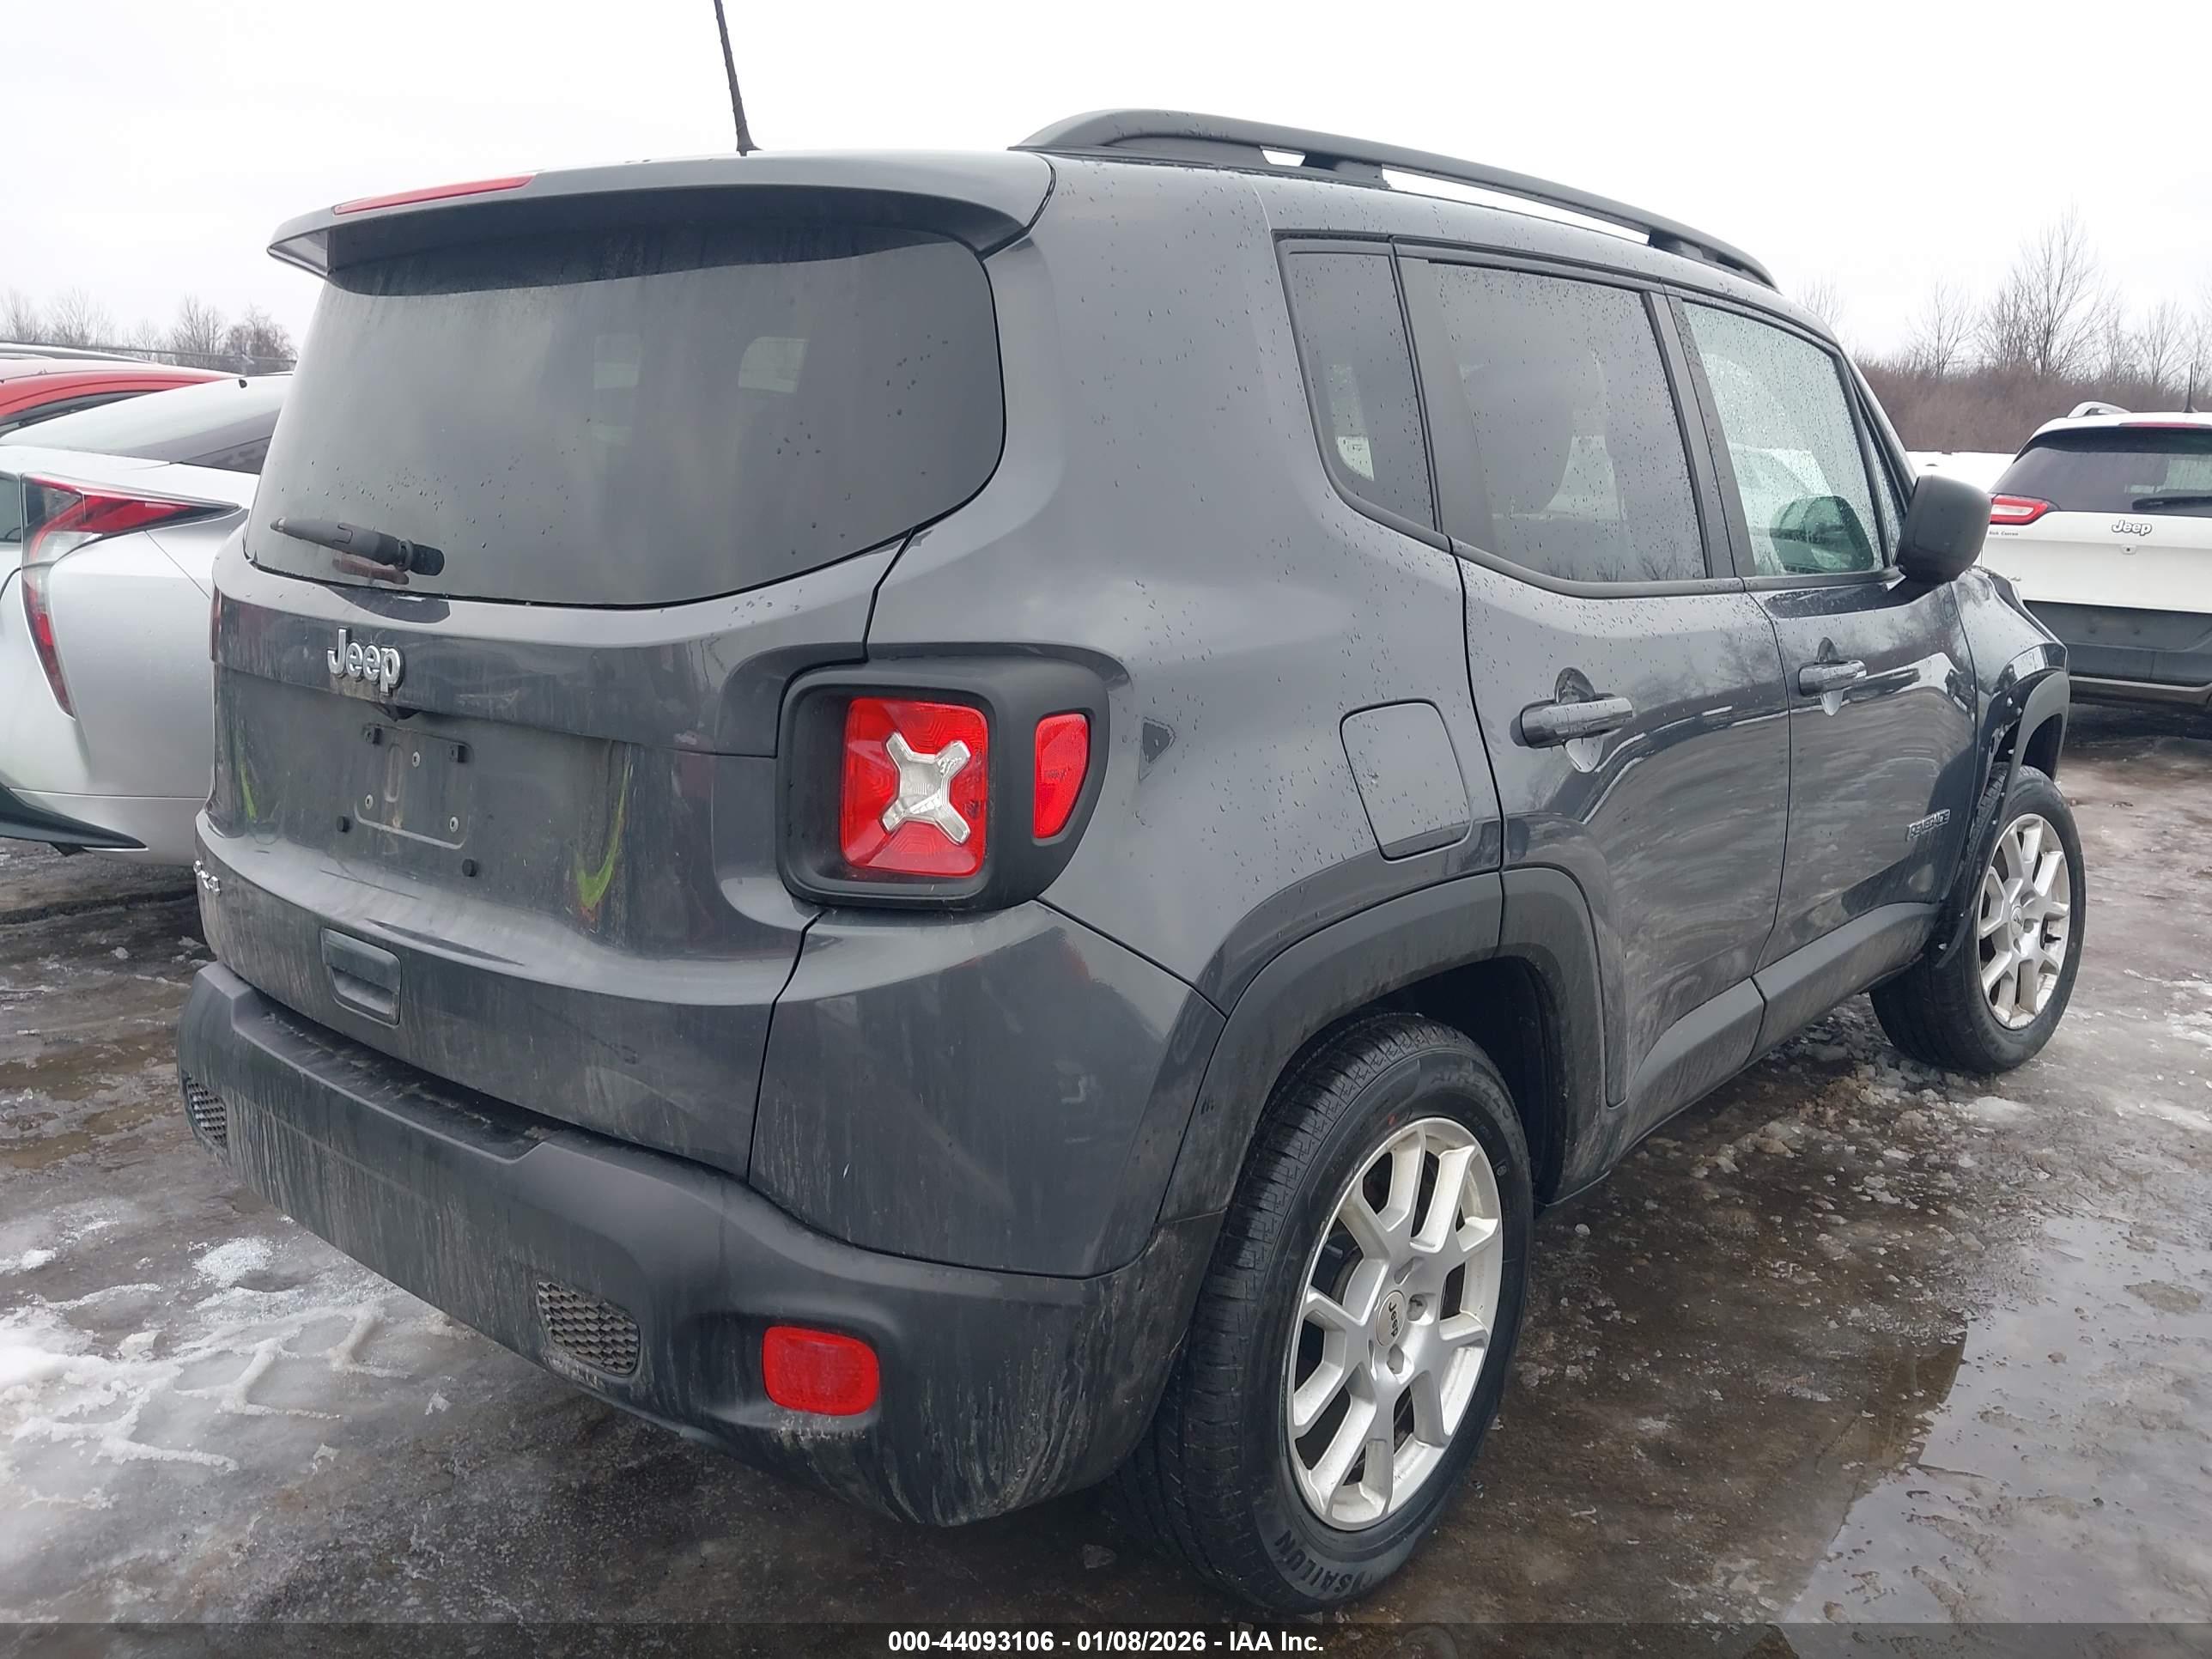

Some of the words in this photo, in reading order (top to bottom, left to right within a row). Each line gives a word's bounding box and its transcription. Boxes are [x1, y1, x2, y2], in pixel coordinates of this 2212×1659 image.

[2112, 519, 2153, 537] Jeep
[326, 627, 404, 696] Jeep
[1388, 1301, 1399, 1338] Jeep
[1274, 1529, 1354, 1594] SAILUN
